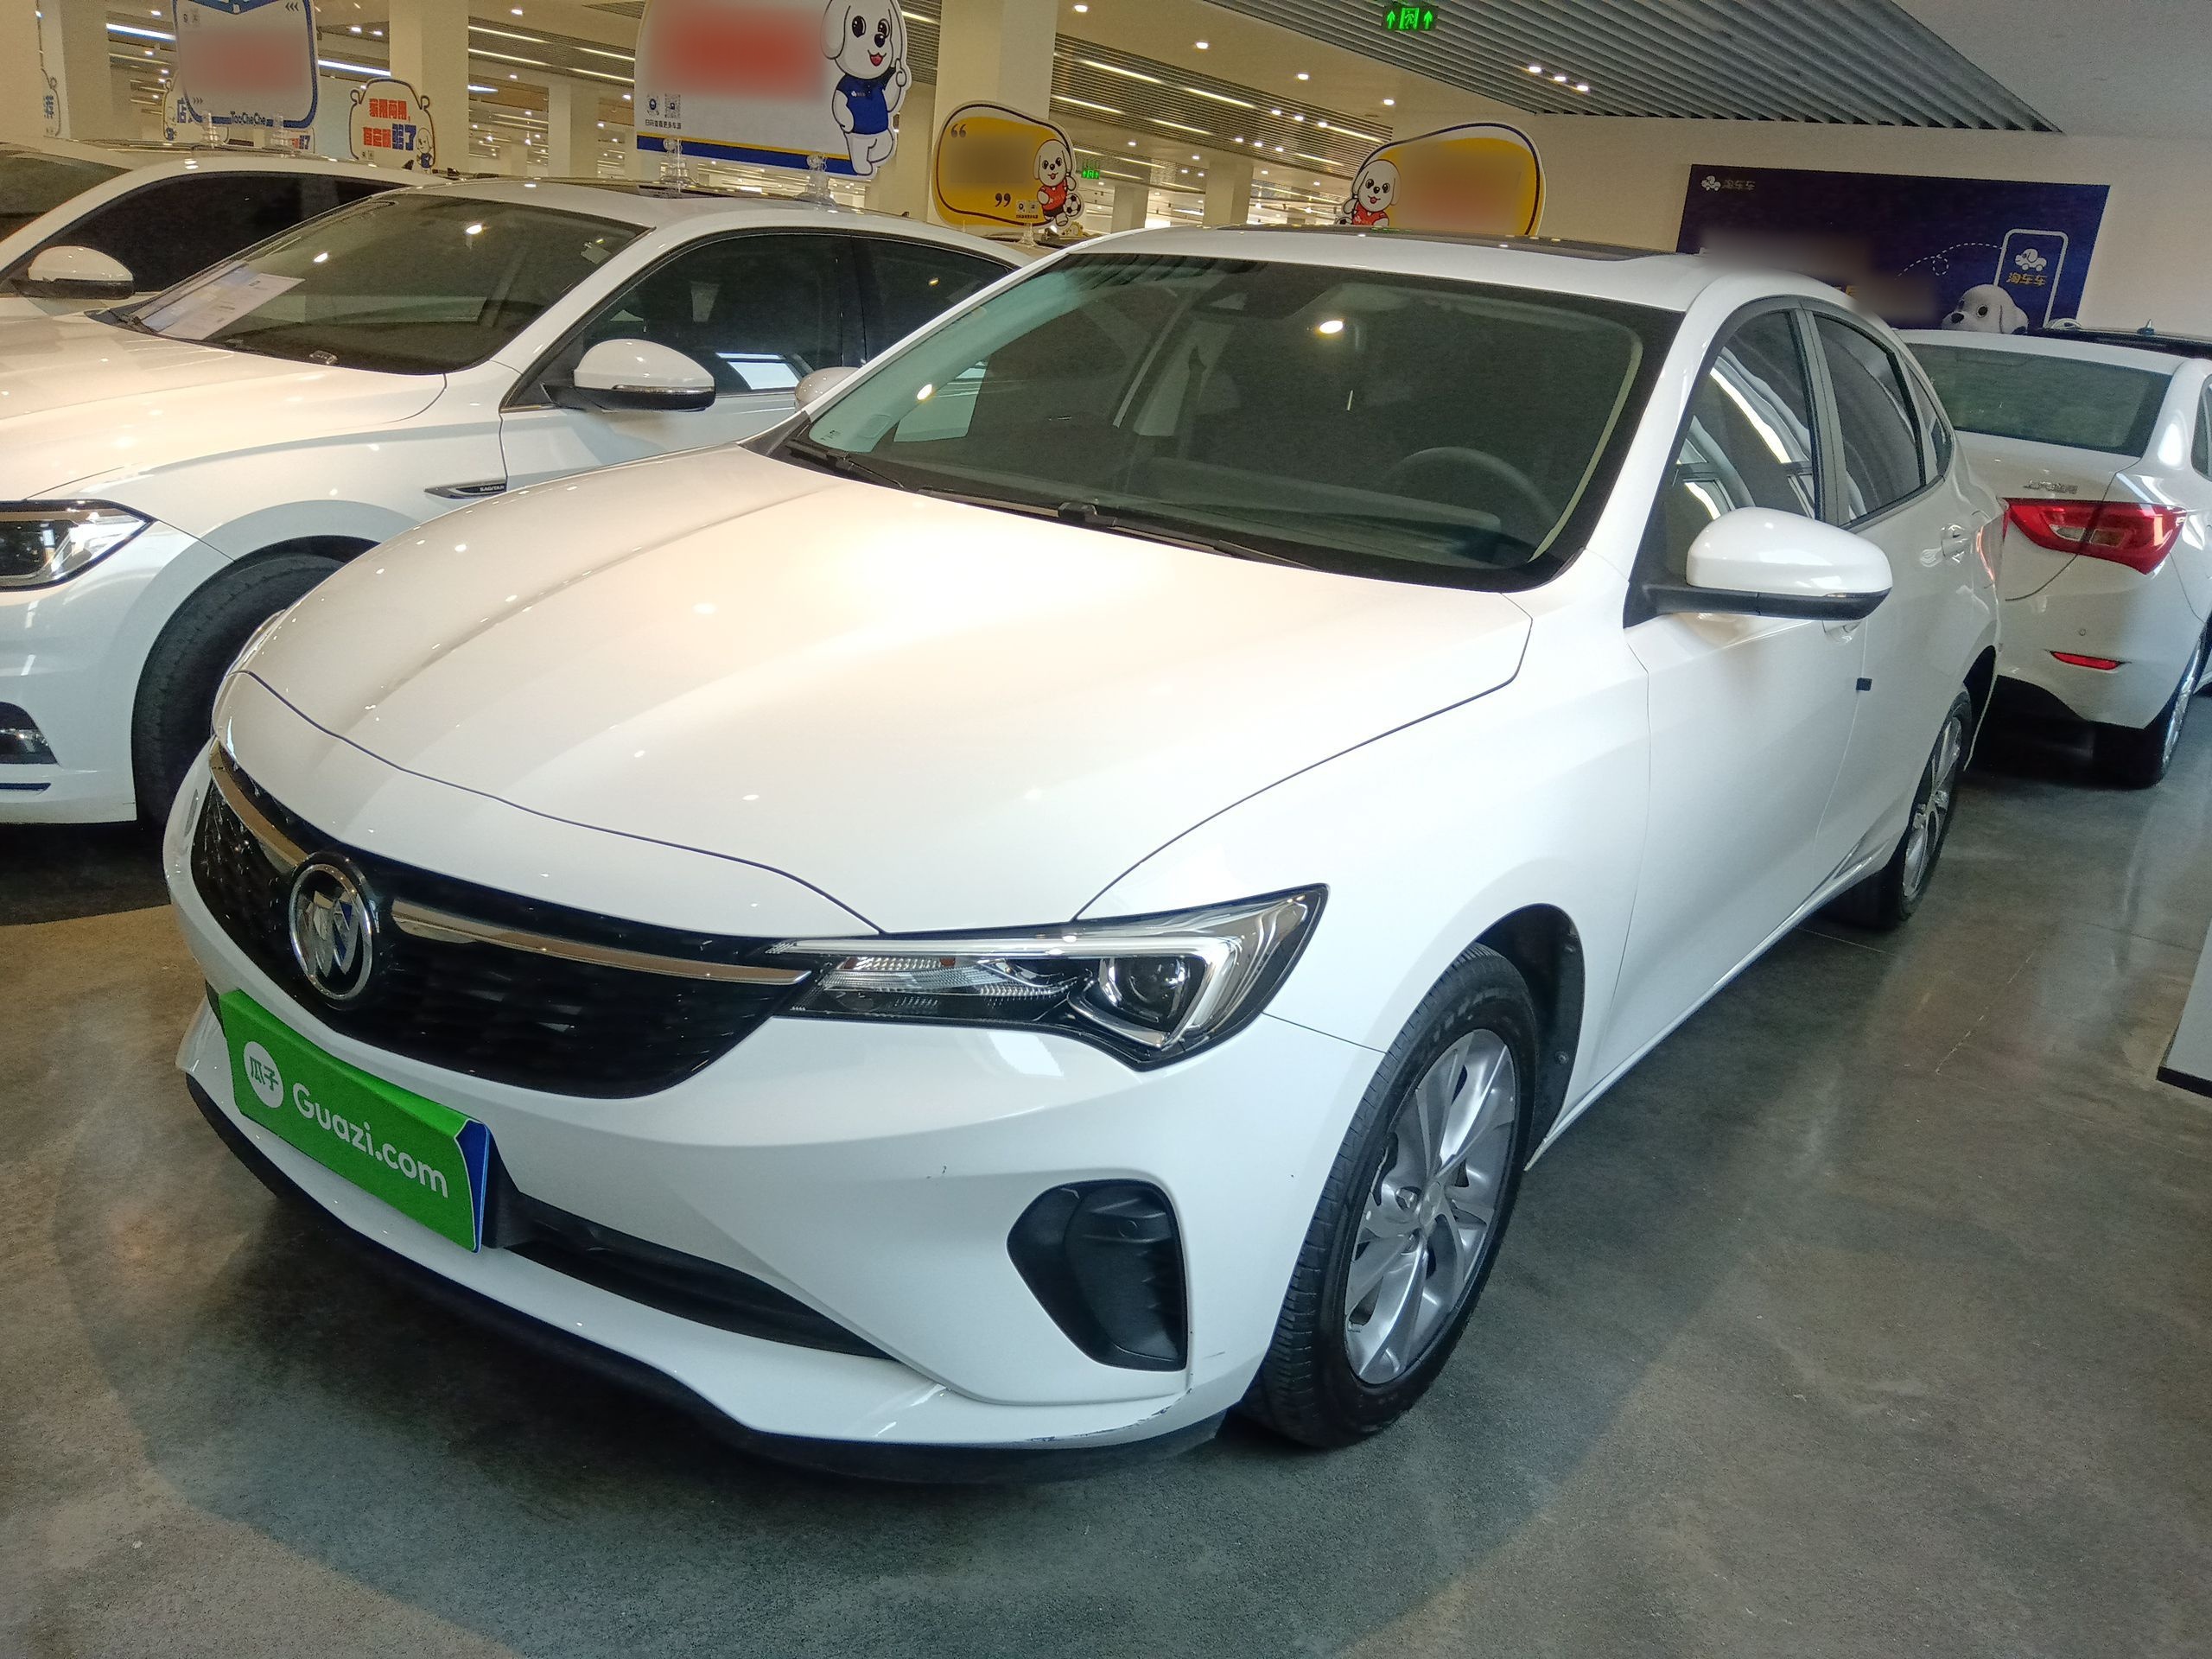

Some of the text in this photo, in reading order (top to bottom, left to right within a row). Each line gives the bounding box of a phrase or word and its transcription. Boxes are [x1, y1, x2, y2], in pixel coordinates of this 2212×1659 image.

[2006, 272, 2047, 286] 淘车车
[250, 1056, 279, 1091] 瓜子
[293, 1084, 448, 1198] Guazi.com
